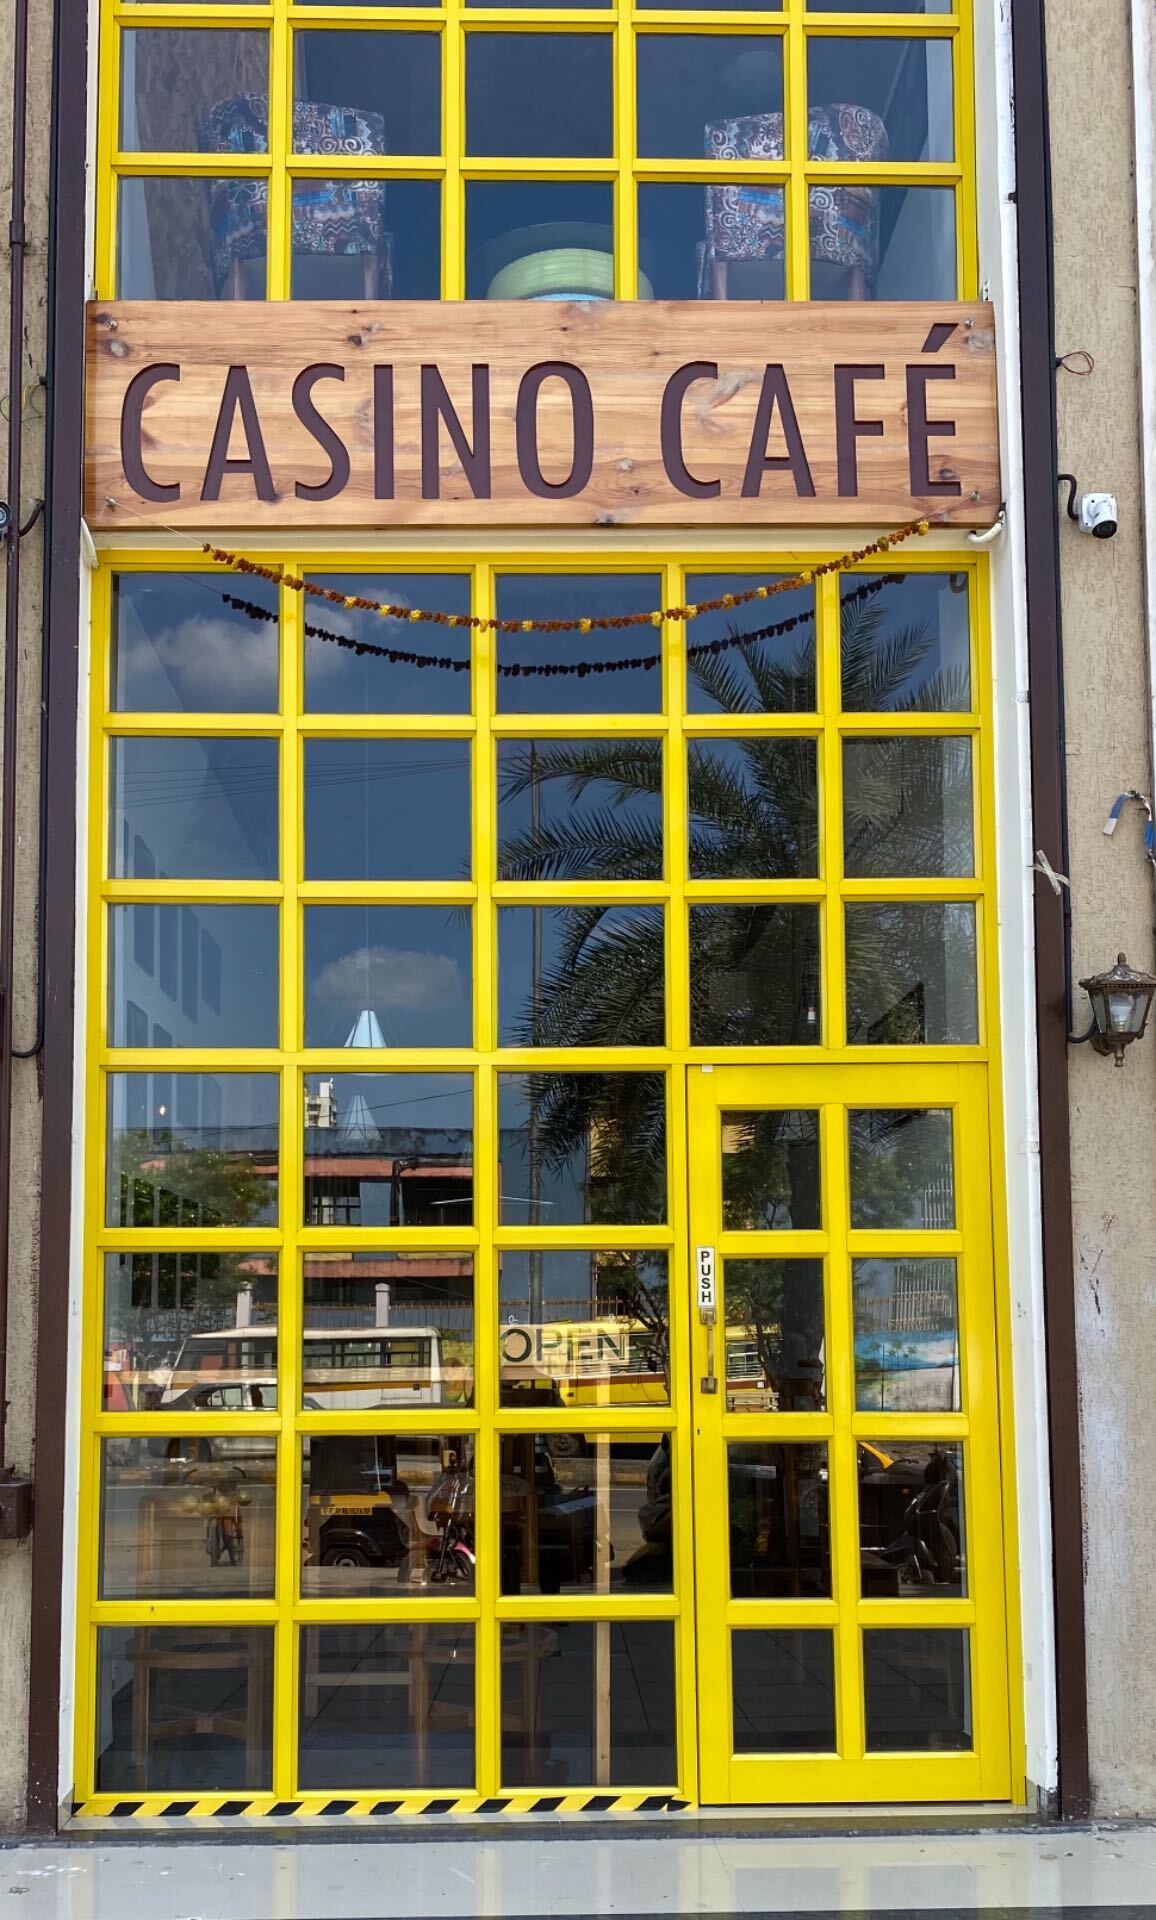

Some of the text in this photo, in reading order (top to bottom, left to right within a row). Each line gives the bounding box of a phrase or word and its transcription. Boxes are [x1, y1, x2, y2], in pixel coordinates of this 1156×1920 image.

[120, 323, 961, 501] CASINO CAFÉ
[701, 1251, 711, 1302] PUSH
[500, 1328, 625, 1362] OPEN
